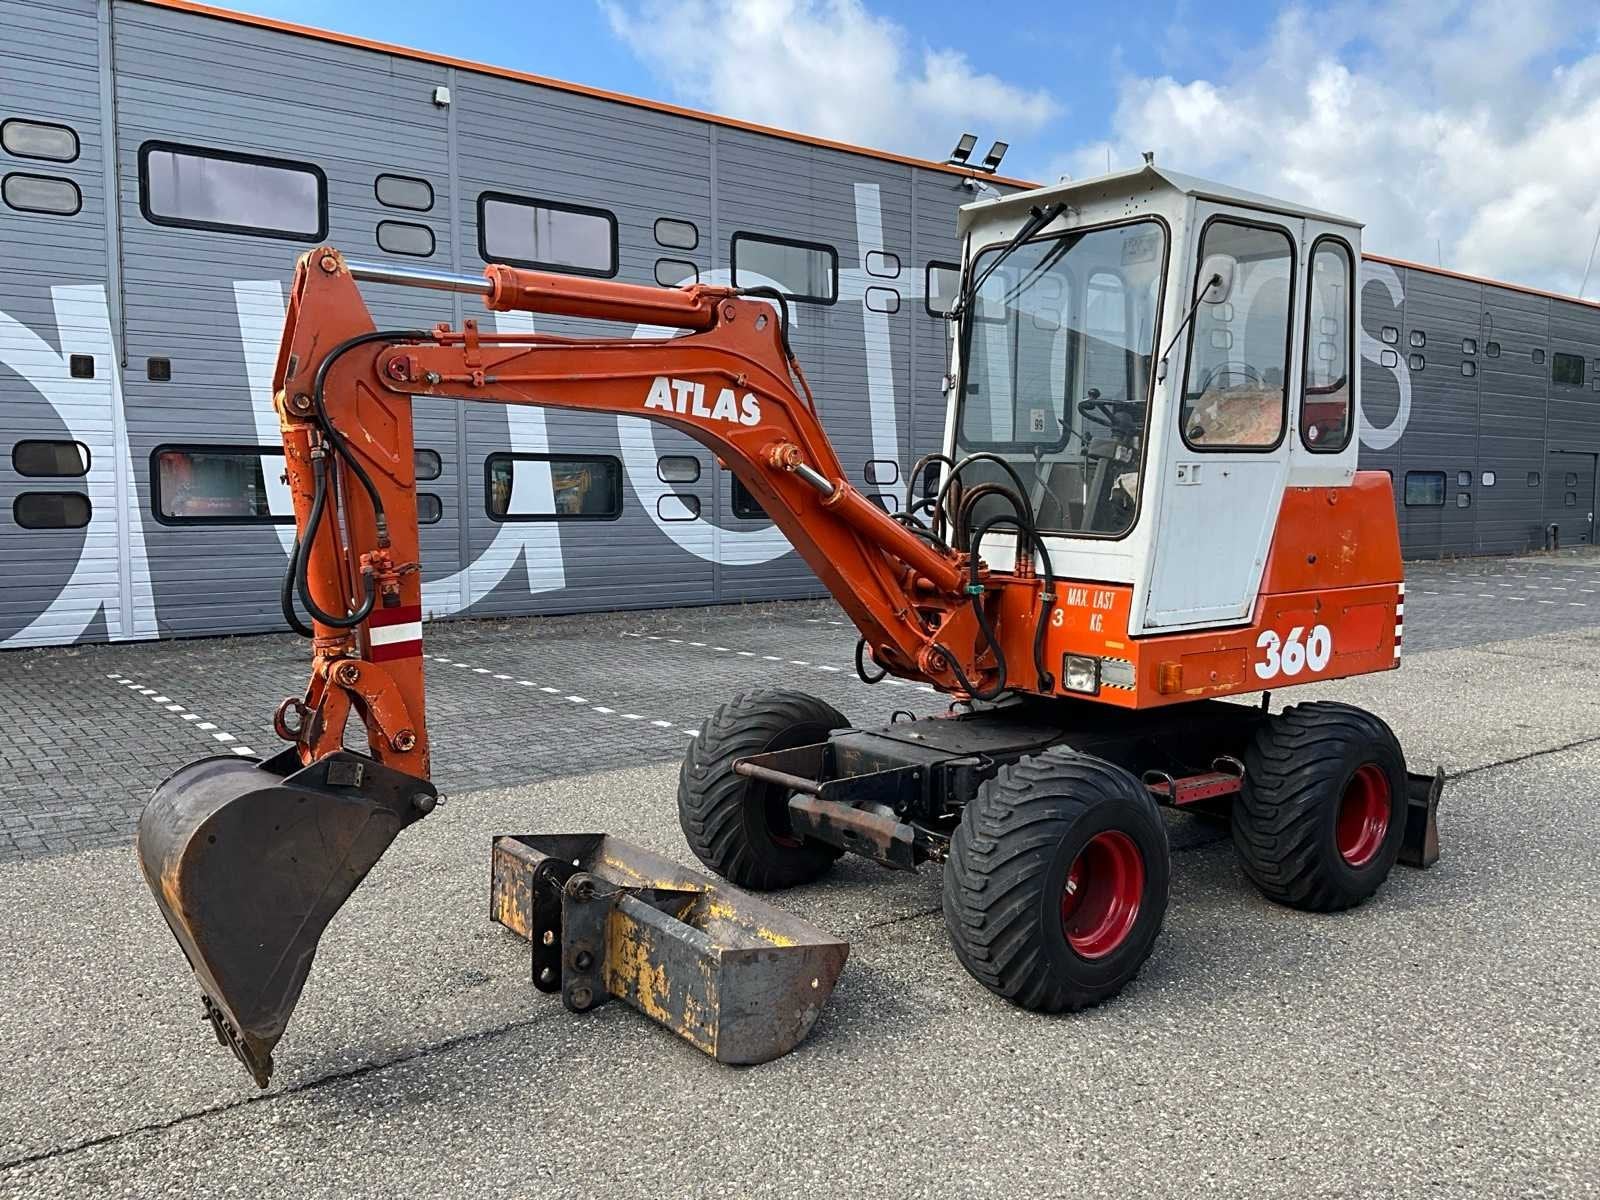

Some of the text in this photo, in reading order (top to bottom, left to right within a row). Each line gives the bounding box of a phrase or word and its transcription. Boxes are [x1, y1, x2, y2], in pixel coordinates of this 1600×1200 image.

[644, 376, 761, 427] ATLAS
[1067, 587, 1116, 609] MAX. LAST
[1052, 608, 1065, 628] 3
[1254, 624, 1331, 680] 360
